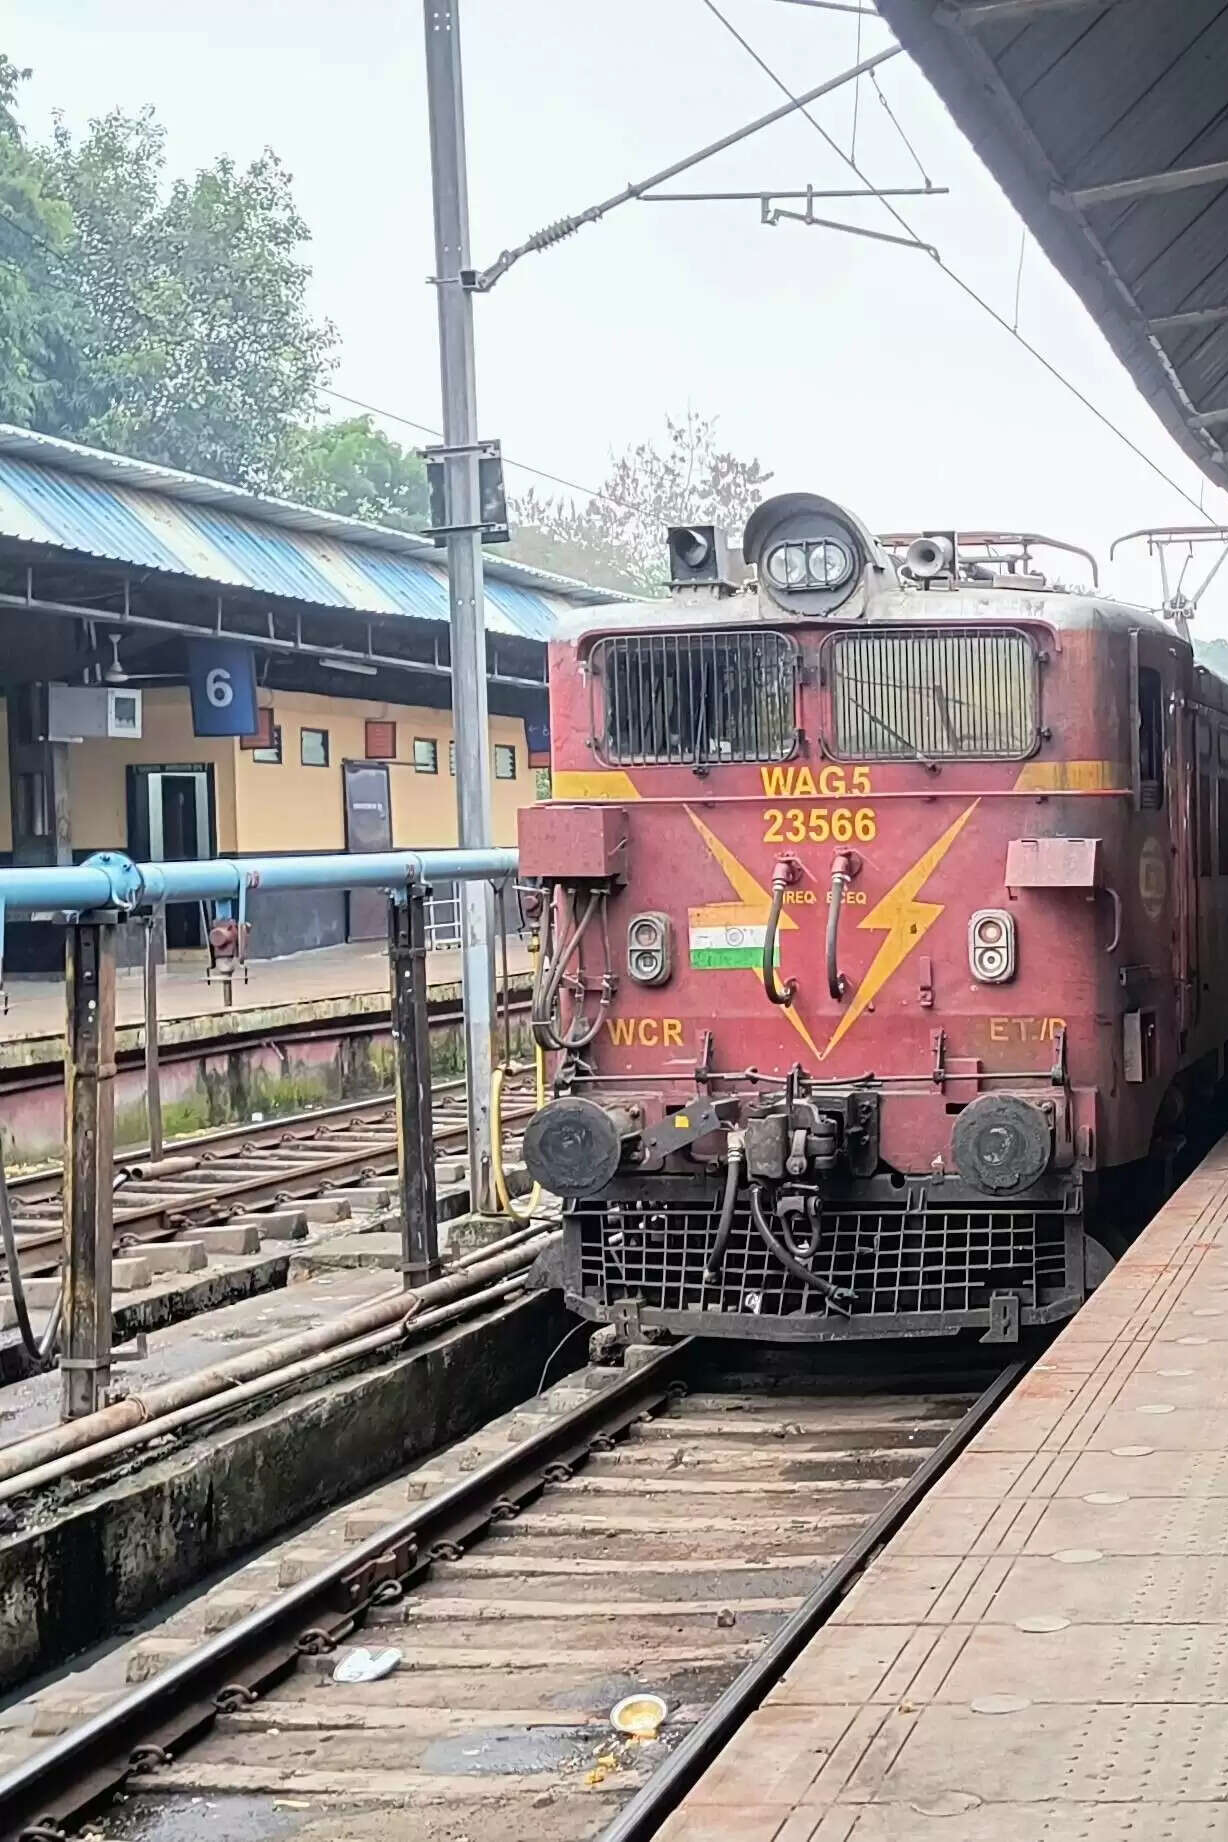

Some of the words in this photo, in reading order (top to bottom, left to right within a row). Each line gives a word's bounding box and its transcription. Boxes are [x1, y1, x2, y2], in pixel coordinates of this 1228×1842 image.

[206, 668, 233, 708] 6
[763, 807, 877, 843] 23566
[606, 1017, 684, 1048] WCR
